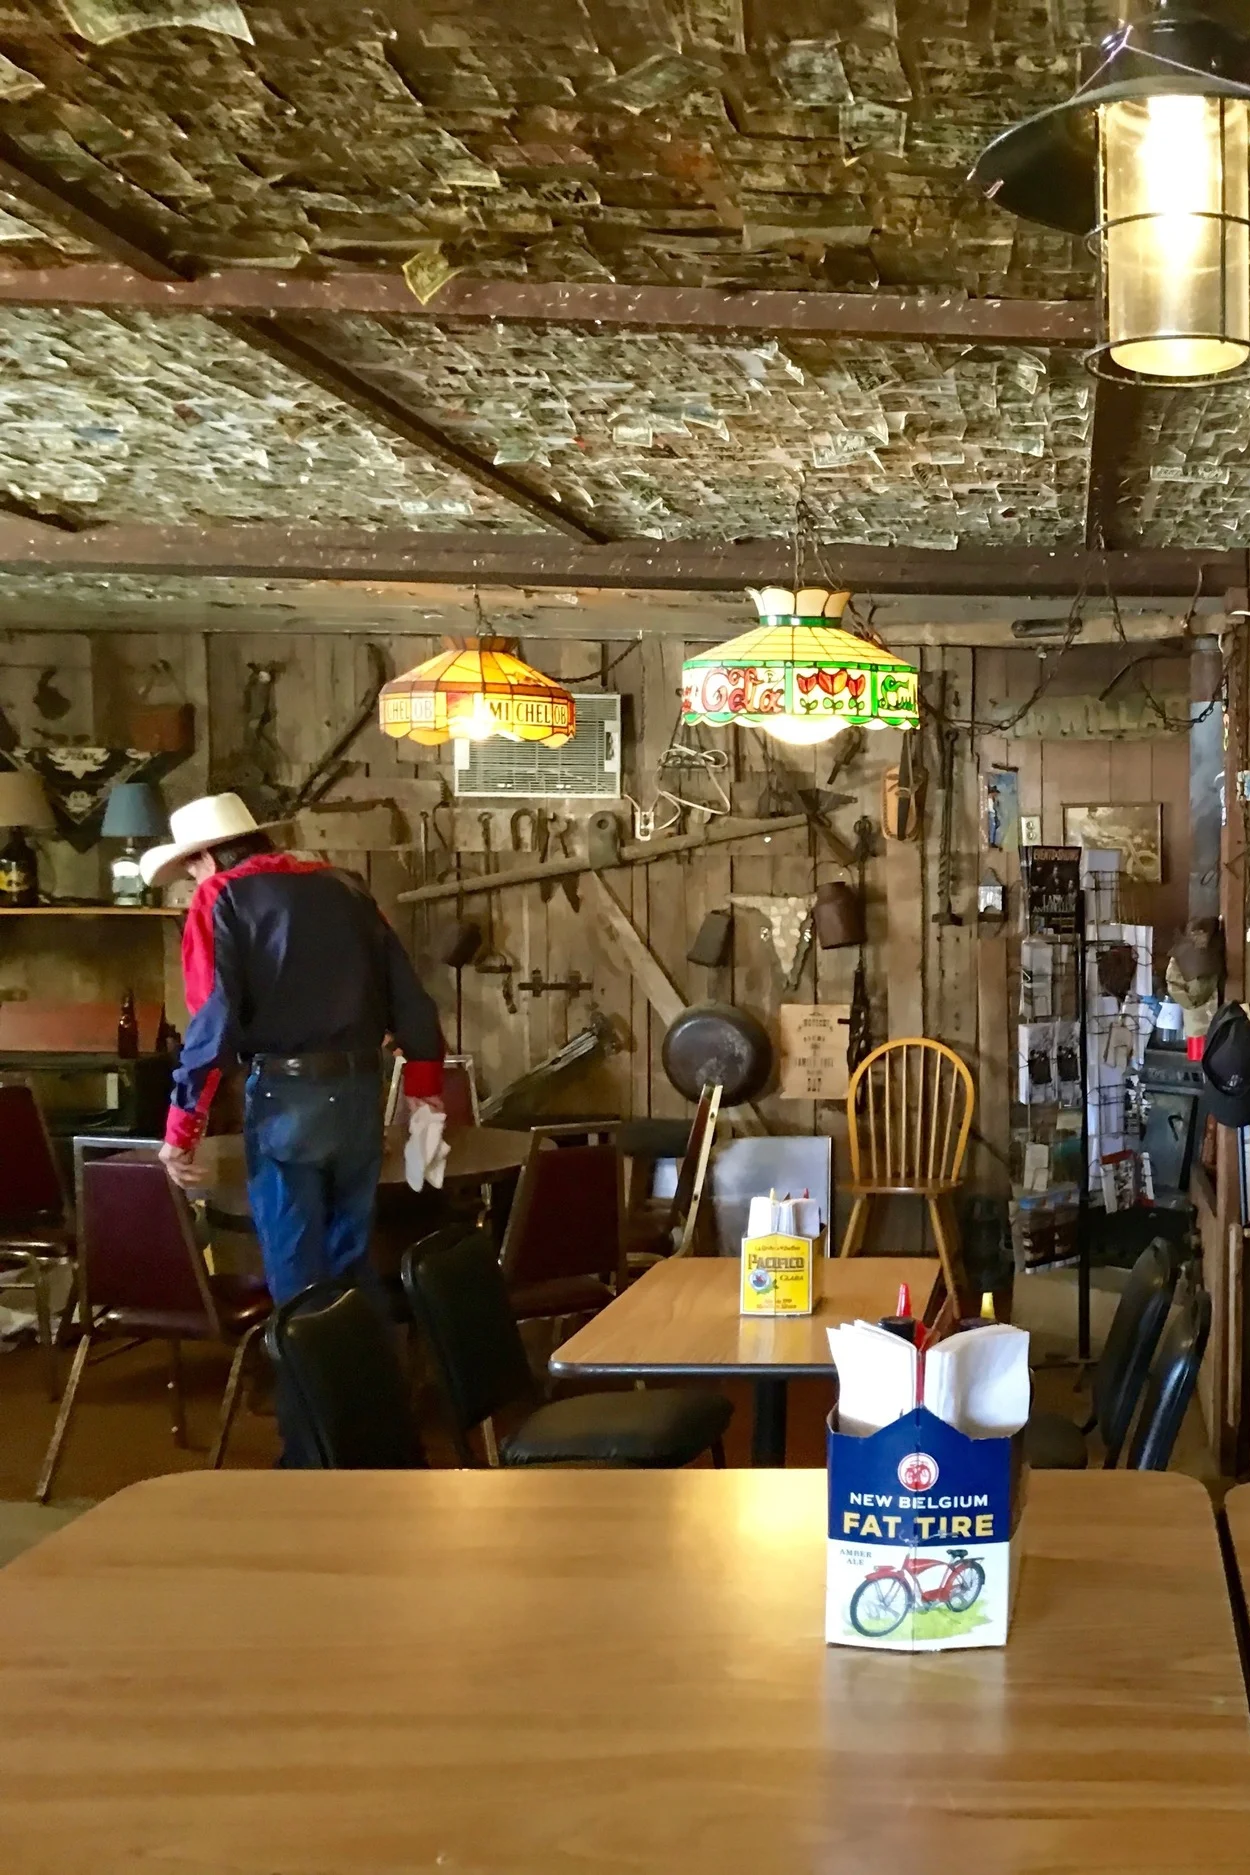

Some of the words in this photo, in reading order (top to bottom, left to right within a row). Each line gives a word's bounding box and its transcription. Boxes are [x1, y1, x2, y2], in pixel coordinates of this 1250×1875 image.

[850, 1492, 893, 1508] NEW
[899, 1494, 988, 1509] BELGIUM
[843, 1511, 902, 1538] FAT
[915, 1513, 994, 1540] TIRE
[839, 1548, 872, 1559] AMBER
[846, 1558, 864, 1566] ALE
